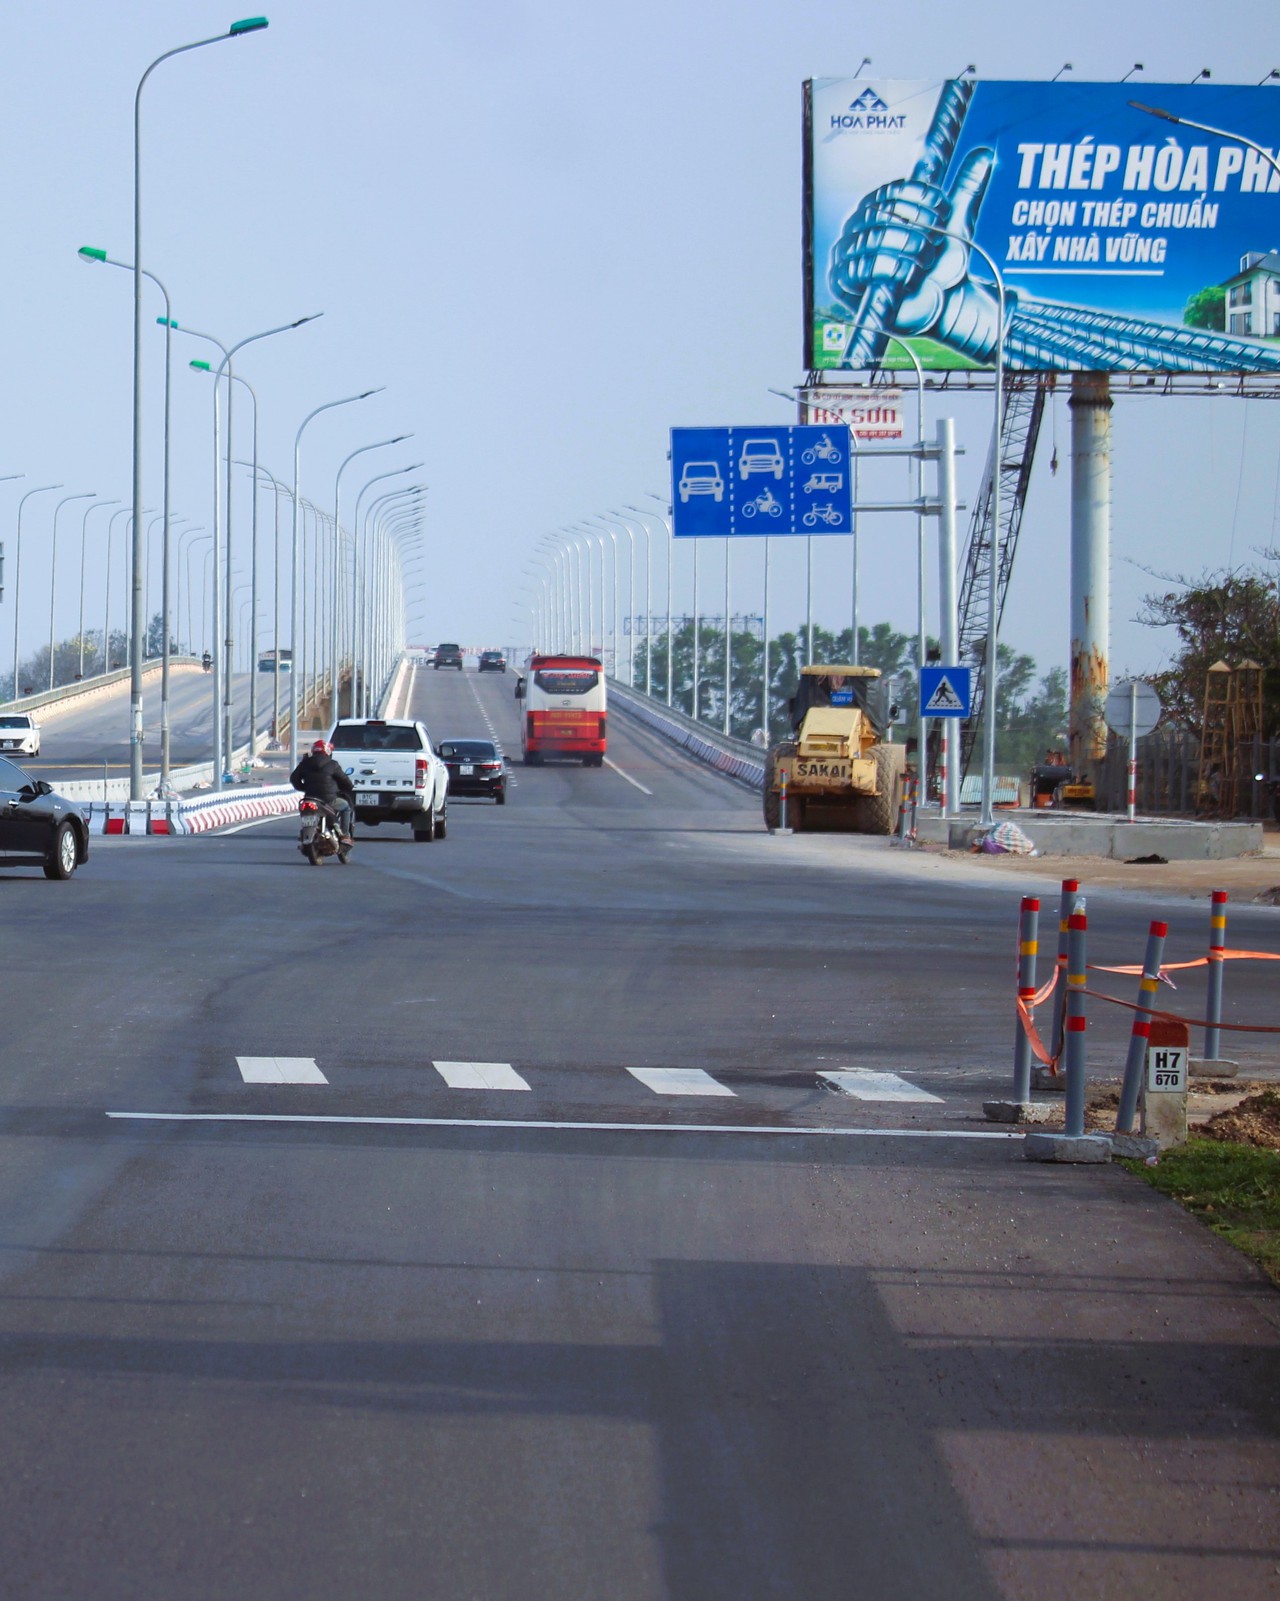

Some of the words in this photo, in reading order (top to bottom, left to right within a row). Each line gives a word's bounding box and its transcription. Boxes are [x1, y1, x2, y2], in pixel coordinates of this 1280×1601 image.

[1017, 135, 1121, 190] THÉP
[1122, 136, 1208, 192] HÒA
[1011, 199, 1077, 234] CHỌN
[1081, 197, 1138, 228] THÉP
[1005, 230, 1051, 262] XÂY
[1052, 231, 1100, 262] NHÀ
[1105, 231, 1168, 263] VỮNG
[797, 764, 846, 778] SAKAI
[1155, 1052, 1181, 1069] H7
[1155, 1074, 1179, 1086] 670
